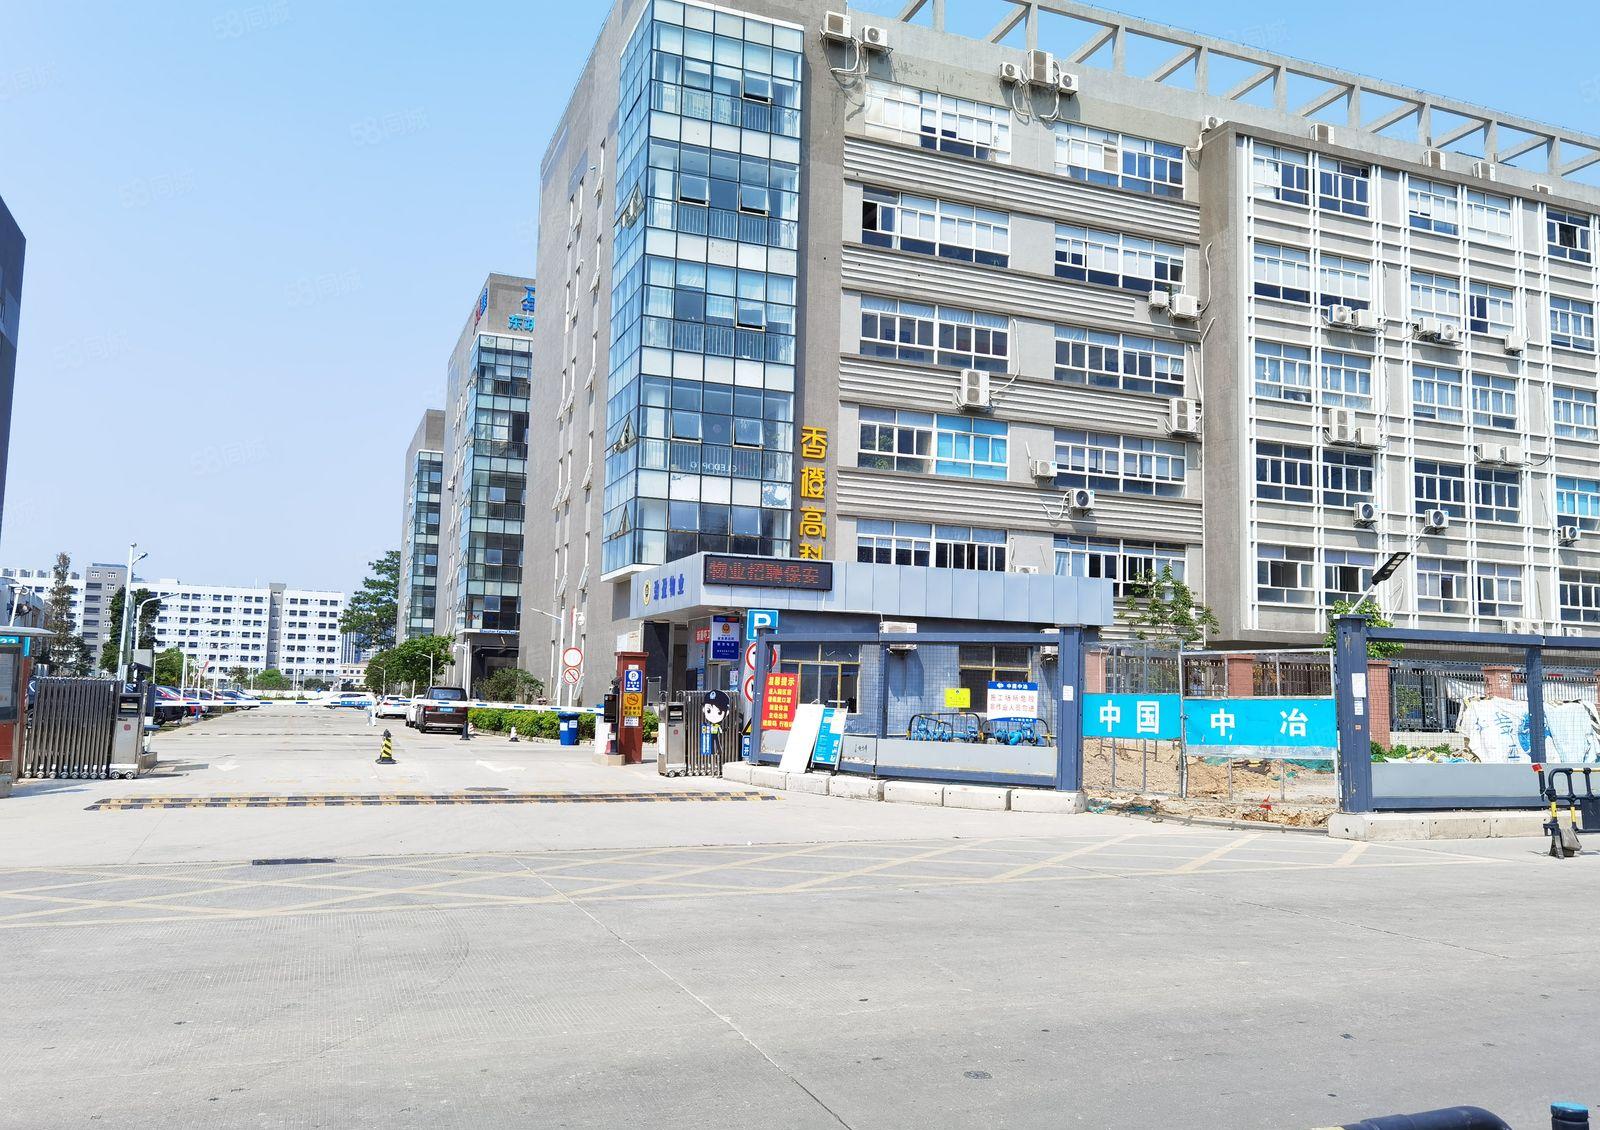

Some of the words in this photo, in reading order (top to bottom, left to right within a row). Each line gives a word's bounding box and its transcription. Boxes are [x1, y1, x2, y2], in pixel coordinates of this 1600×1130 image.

[799, 425, 828, 560] 香橙高科
[709, 560, 820, 584] 物业招聘保安
[754, 613, 771, 637] P
[1099, 700, 1159, 734] 中国
[1210, 708, 1308, 737] 中冶
